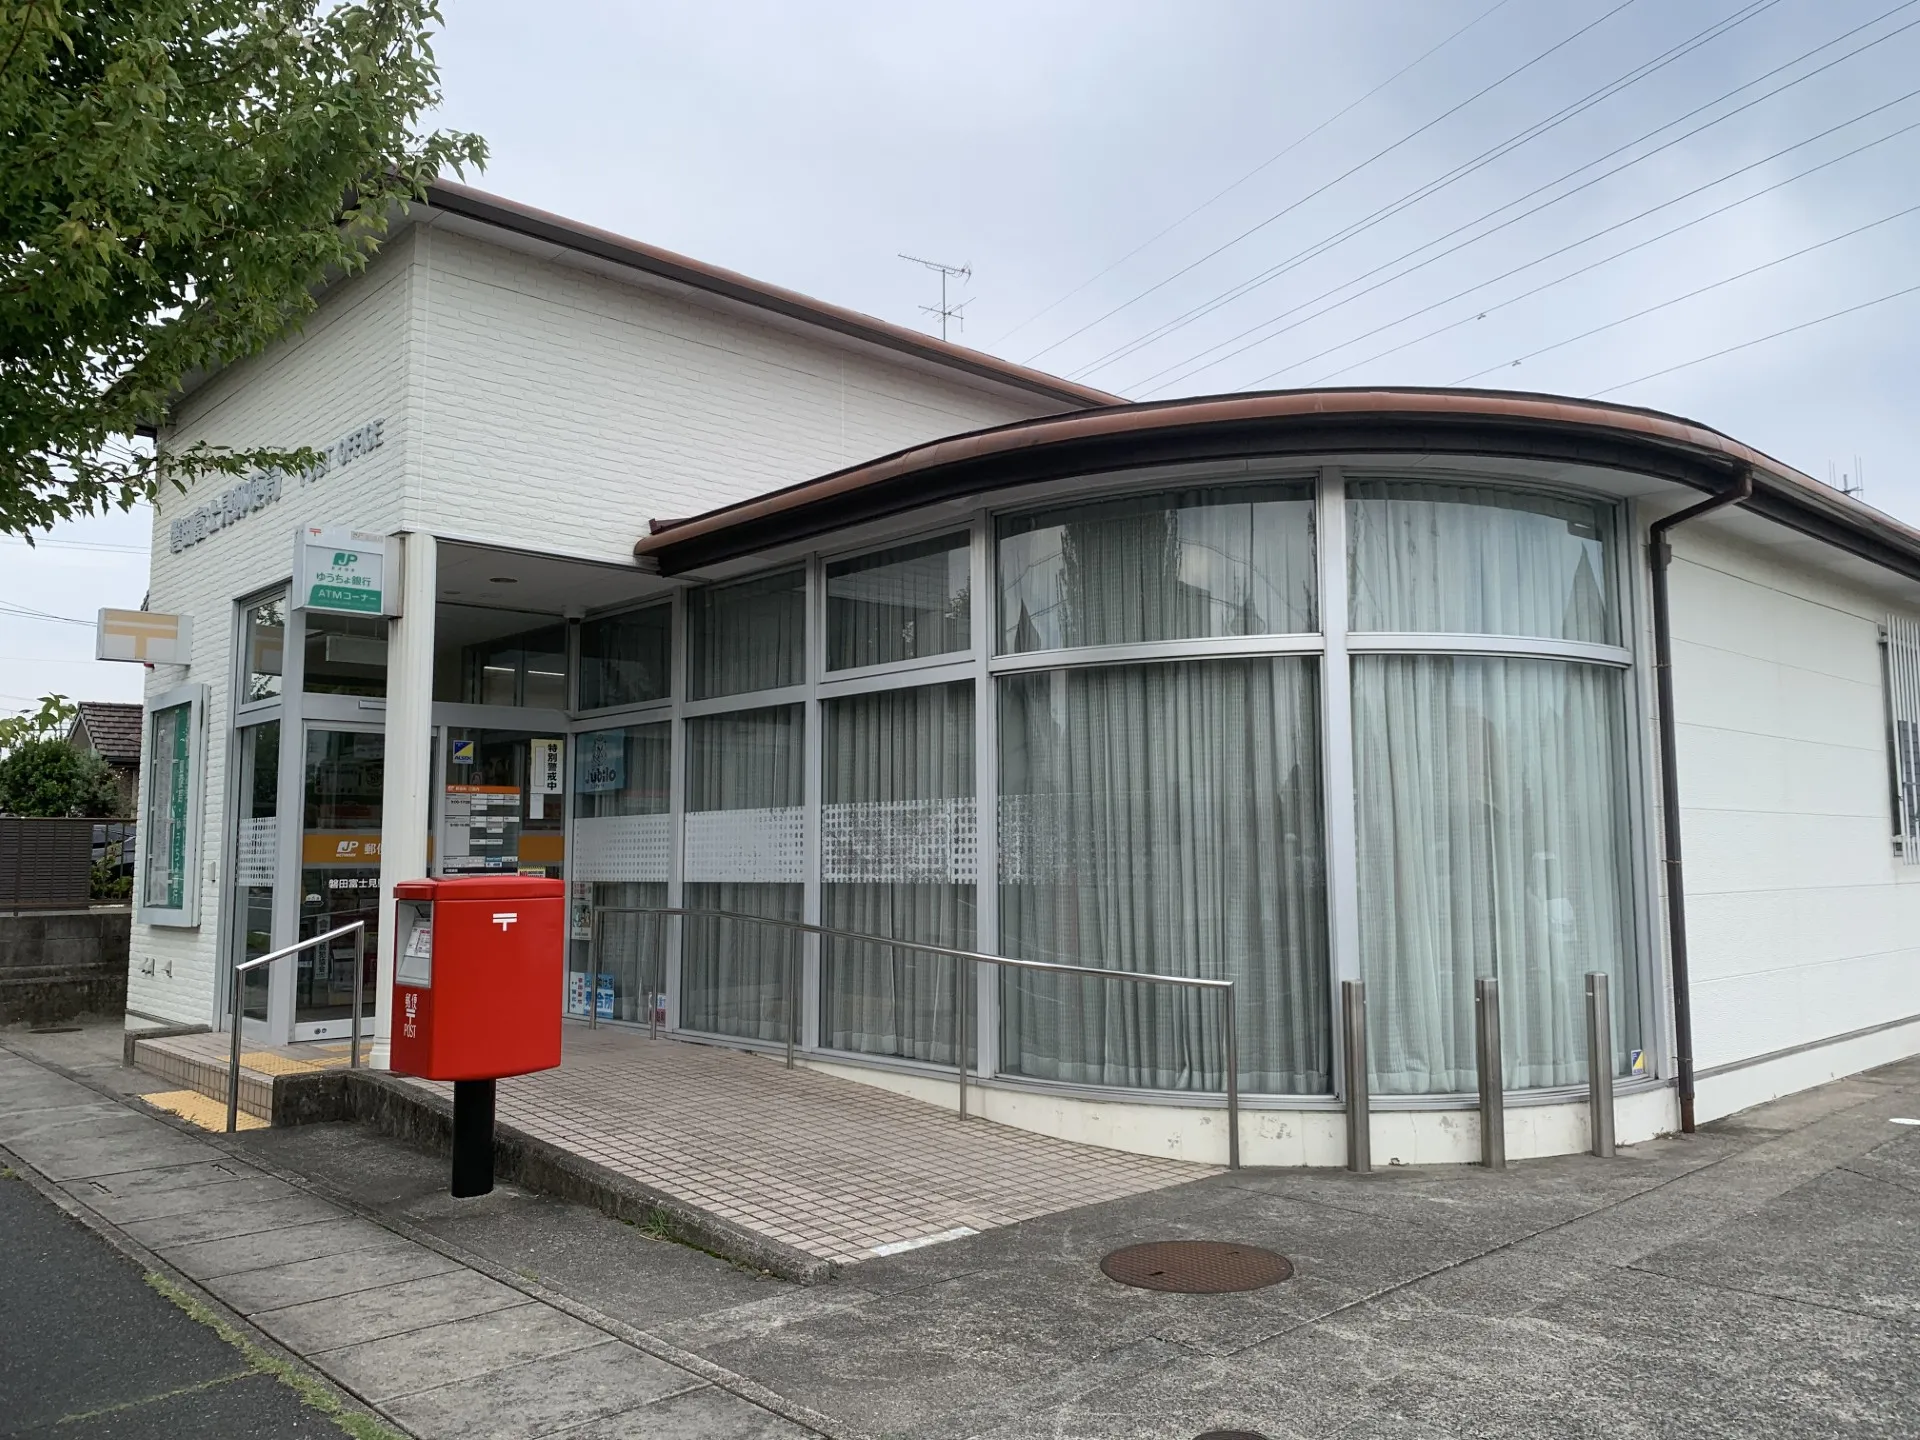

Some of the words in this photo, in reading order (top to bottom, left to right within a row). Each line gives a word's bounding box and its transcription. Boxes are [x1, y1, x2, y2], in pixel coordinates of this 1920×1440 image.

[337, 418, 384, 466] OFFICE
[333, 552, 358, 567] JP
[316, 572, 372, 587] ゆうちょ銀行
[318, 589, 377, 602] ATMコーナー
[547, 743, 558, 791] 特別警戒中
[336, 840, 359, 854] JP
[328, 878, 381, 889] 磐田富士見
[405, 993, 418, 1010] 郵便
[403, 1025, 416, 1039] POST
